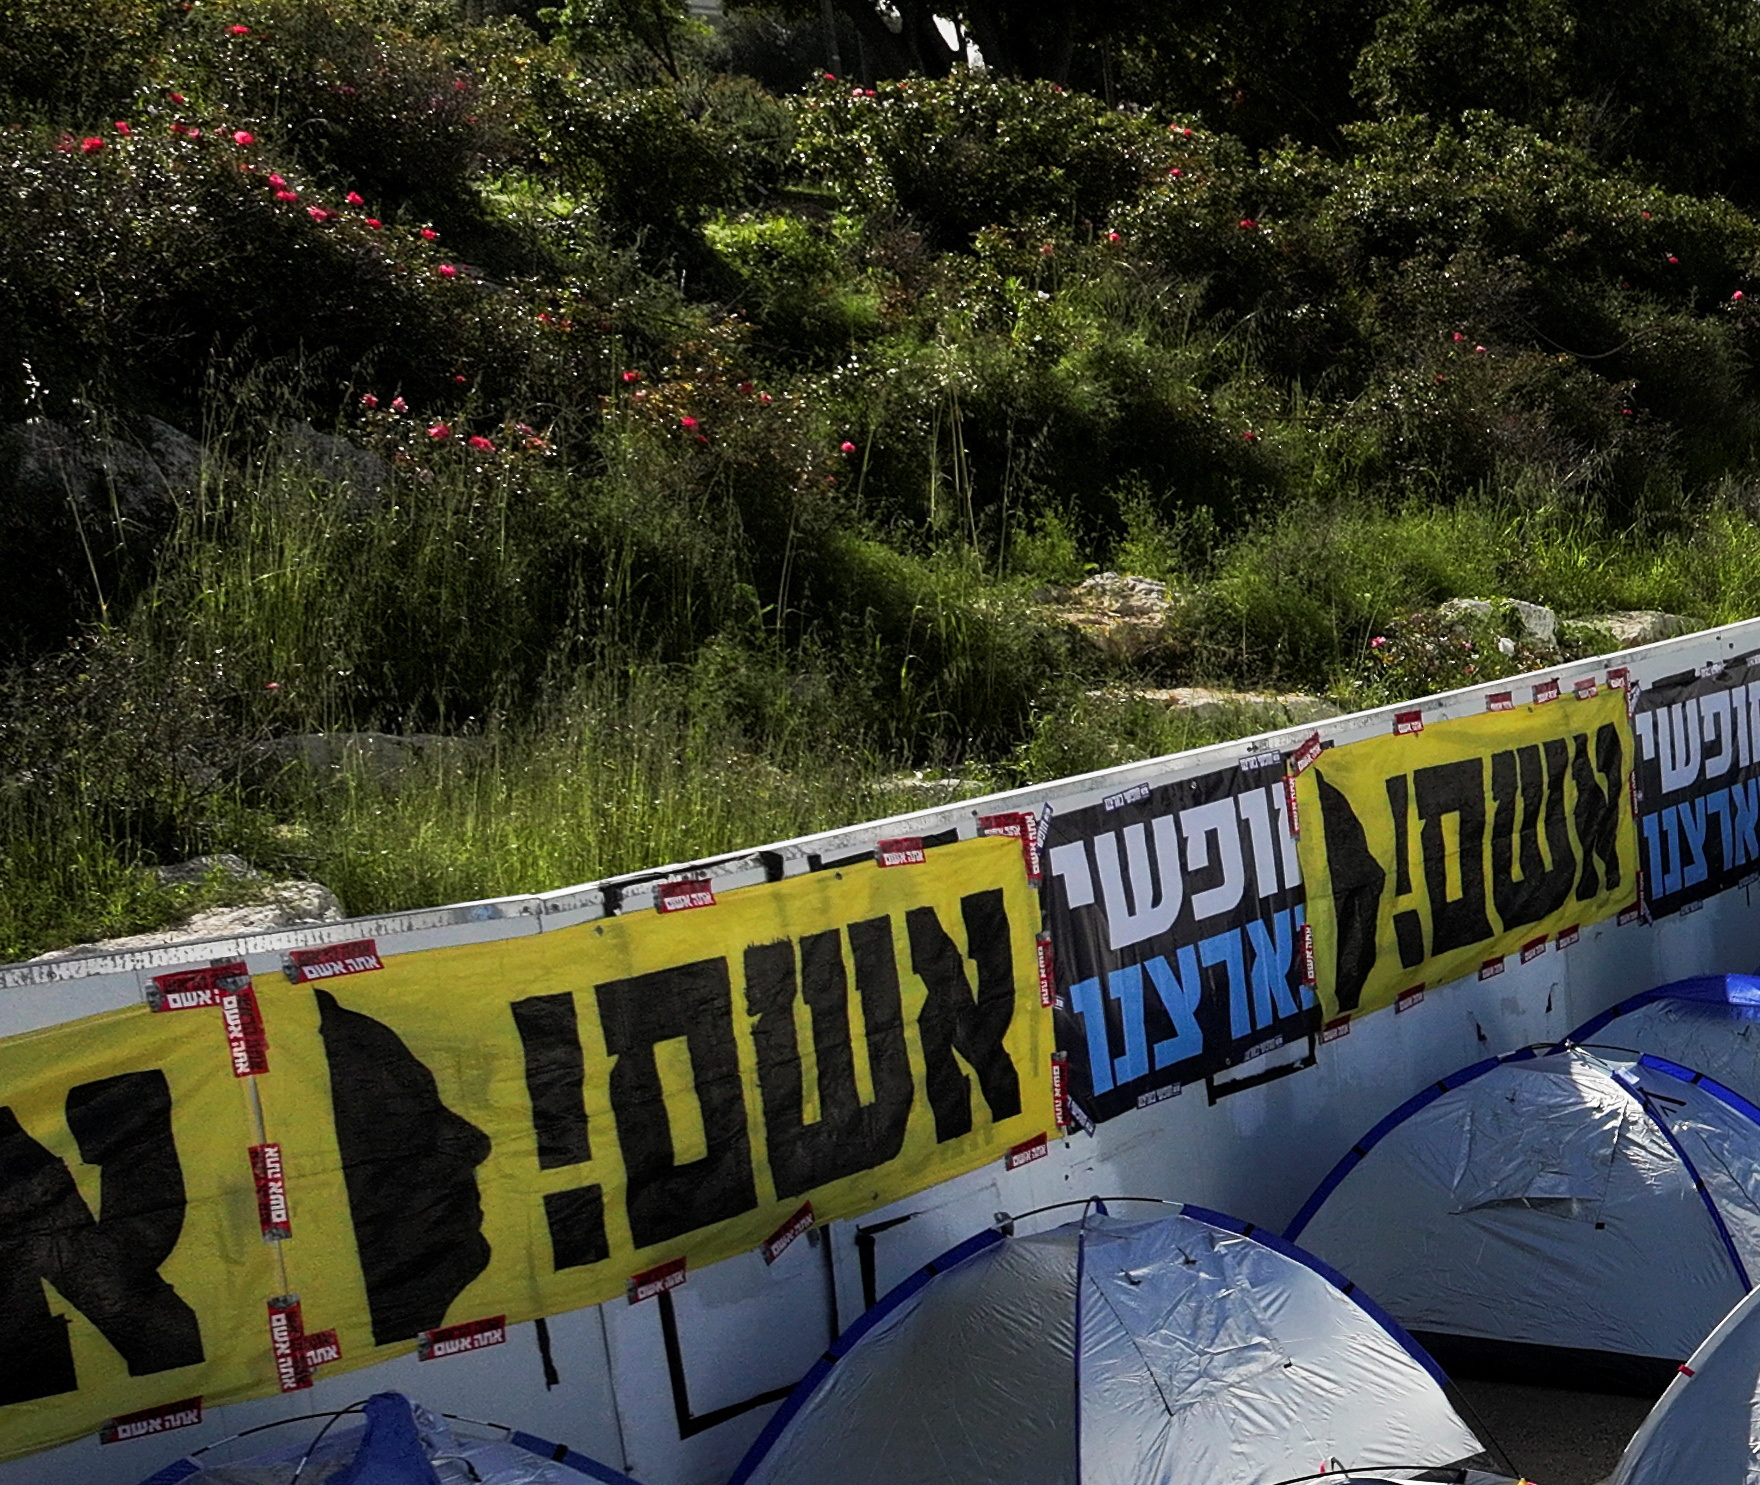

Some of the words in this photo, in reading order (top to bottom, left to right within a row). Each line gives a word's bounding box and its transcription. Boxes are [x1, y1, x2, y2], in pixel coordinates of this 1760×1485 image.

[1385, 722, 1622, 969] אשם!
[302, 964, 346, 980] אשם
[347, 955, 381, 974] אתה
[167, 989, 212, 1009] אשם
[1071, 903, 1318, 1097] ארצנו
[222, 995, 244, 1038] אשם
[232, 1040, 250, 1075] אתה
[510, 884, 1023, 1270] אשם!
[265, 1146, 282, 1180] אתה
[269, 1182, 288, 1223] אשם
[271, 1313, 292, 1356] אשם
[433, 1336, 473, 1358] אשם
[473, 1327, 504, 1347] אתה
[306, 1345, 339, 1366] אתה
[276, 1356, 297, 1389] אתה
[117, 1418, 163, 1440] אשם
[162, 1408, 199, 1430] אתה
